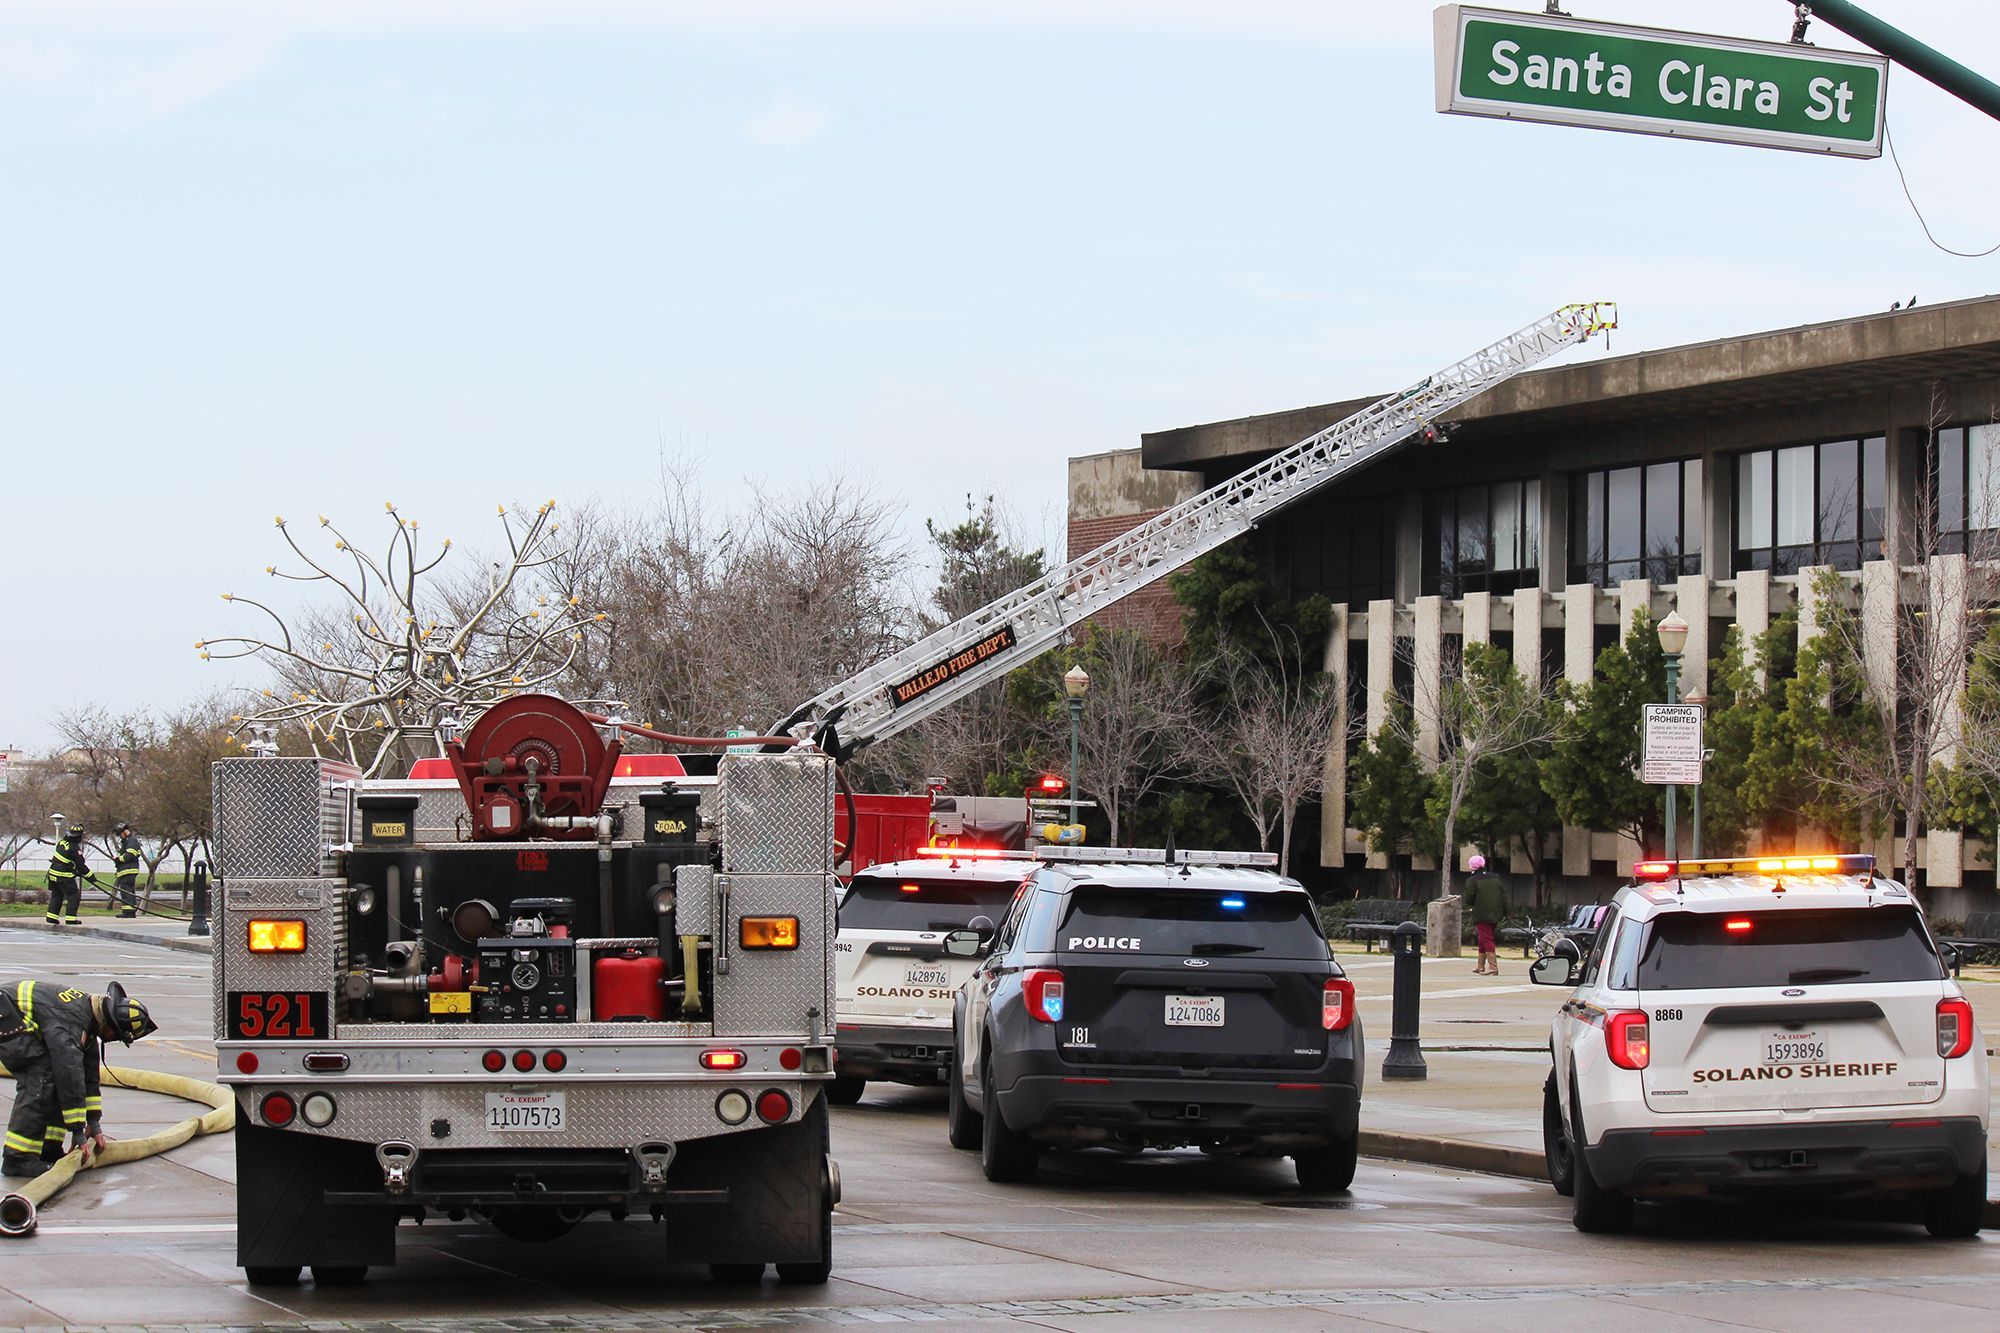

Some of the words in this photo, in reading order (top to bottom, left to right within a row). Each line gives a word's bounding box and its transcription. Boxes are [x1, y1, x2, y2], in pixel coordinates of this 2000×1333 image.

[1487, 39, 1632, 98] Santa
[1658, 59, 1780, 115] Clara
[1803, 77, 1854, 123] St
[897, 665, 948, 700] VALLEJO
[949, 648, 977, 674] FIRE
[1655, 707, 1692, 715] CAMPING
[1649, 715, 1697, 724] PROHIBITED
[375, 826, 403, 834] WATER
[1068, 936, 1142, 950] POLICE
[907, 971, 946, 983] 1428976
[857, 987, 924, 998] SOLANO
[239, 994, 315, 1037] 521
[1169, 1007, 1221, 1022] 1247086
[1655, 1009, 1683, 1021] 8860
[1071, 1027, 1088, 1043] 181
[1767, 1042, 1824, 1060] 1593896
[1693, 1066, 1793, 1083] SOLANO
[1800, 1063, 1897, 1078] SHERIFF
[491, 1107, 561, 1126] 1107573
